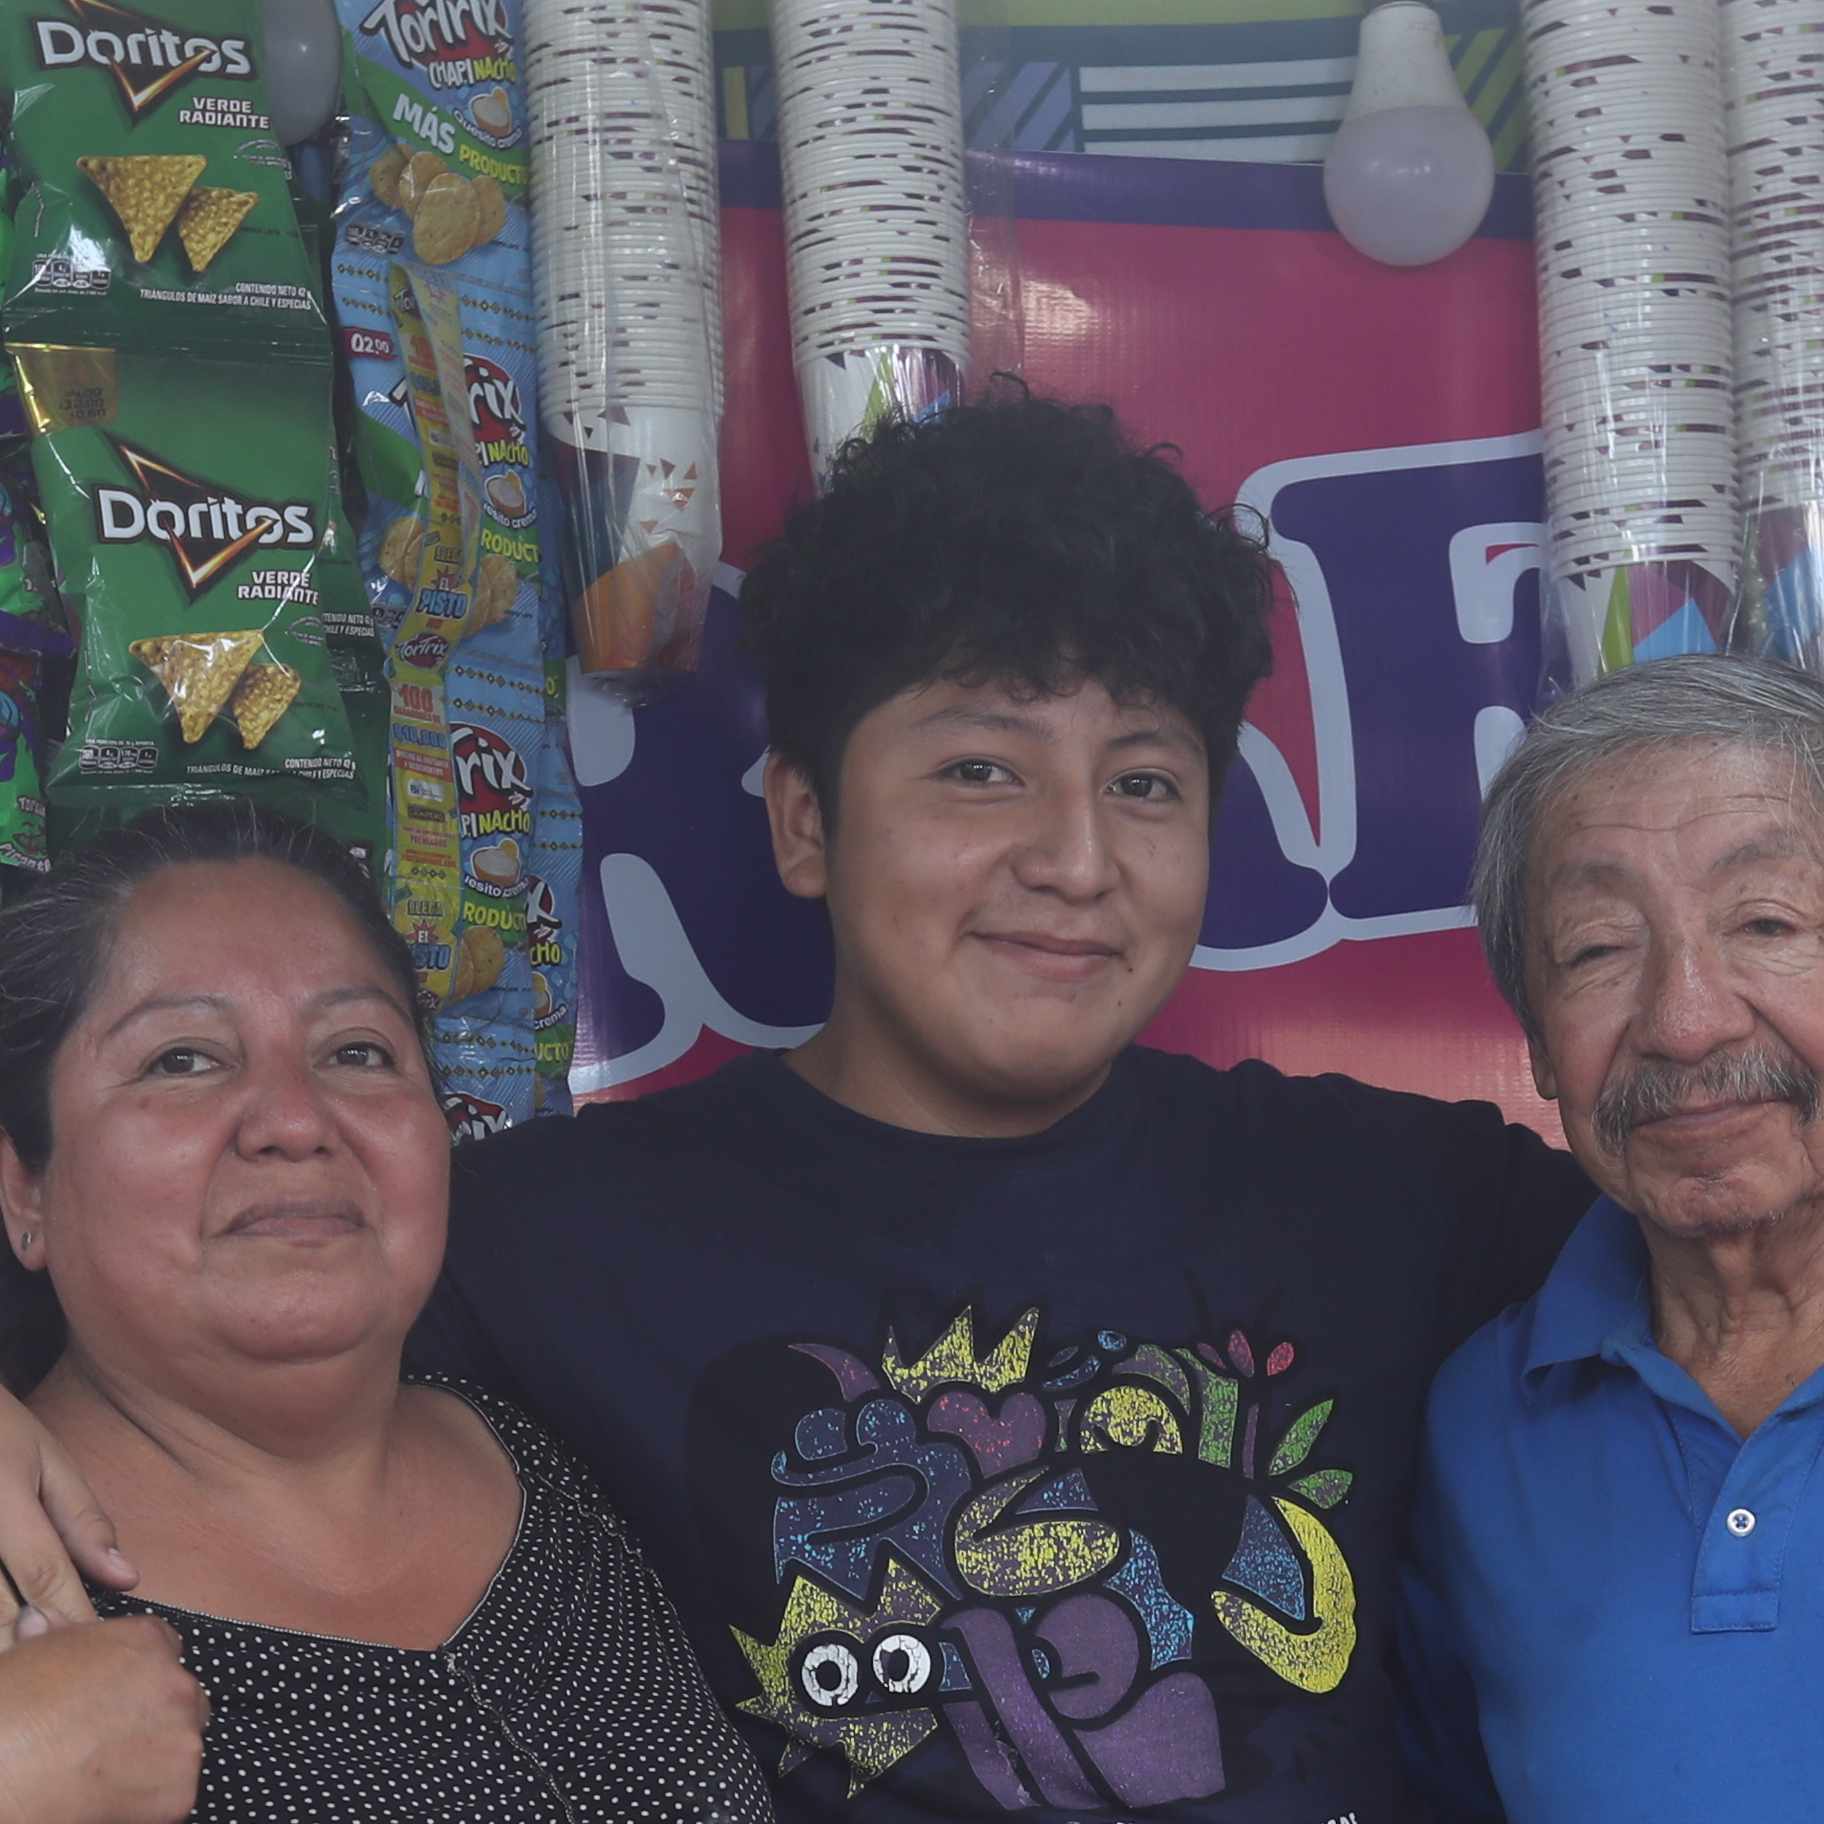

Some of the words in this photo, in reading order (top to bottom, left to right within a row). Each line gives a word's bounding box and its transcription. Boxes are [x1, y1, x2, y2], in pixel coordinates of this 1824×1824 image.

[36, 20, 252, 76] Doritos
[193, 97, 252, 114] VERDE
[179, 110, 270, 130] RADIANTE
[393, 93, 456, 154] MÁS
[459, 144, 526, 185] PRODUCT
[235, 281, 277, 295] CONTENIDO
[277, 284, 296, 296] NETO
[297, 286, 306, 298] 42
[140, 287, 185, 303] TRIÁNGULOS
[187, 290, 197, 303] DE
[197, 291, 217, 305] MAÍZ
[218, 293, 243, 306] SABOR
[250, 296, 270, 309] CHILE
[277, 297, 312, 311] ESPECIAS
[98, 488, 314, 545] Doritos
[252, 571, 311, 588] VERDE
[438, 577, 451, 590] EL
[238, 585, 319, 606] RADIANTE
[416, 588, 469, 619] PISTO
[347, 613, 363, 625] NETO
[345, 624, 375, 638] ESPECIAS
[399, 685, 434, 714] 100
[186, 762, 232, 774] TRIÁNGULOS
[232, 764, 243, 776] DE
[285, 757, 322, 770] CONTENIDO
[323, 757, 342, 769] NETO
[322, 768, 354, 780] ESPECIAS
